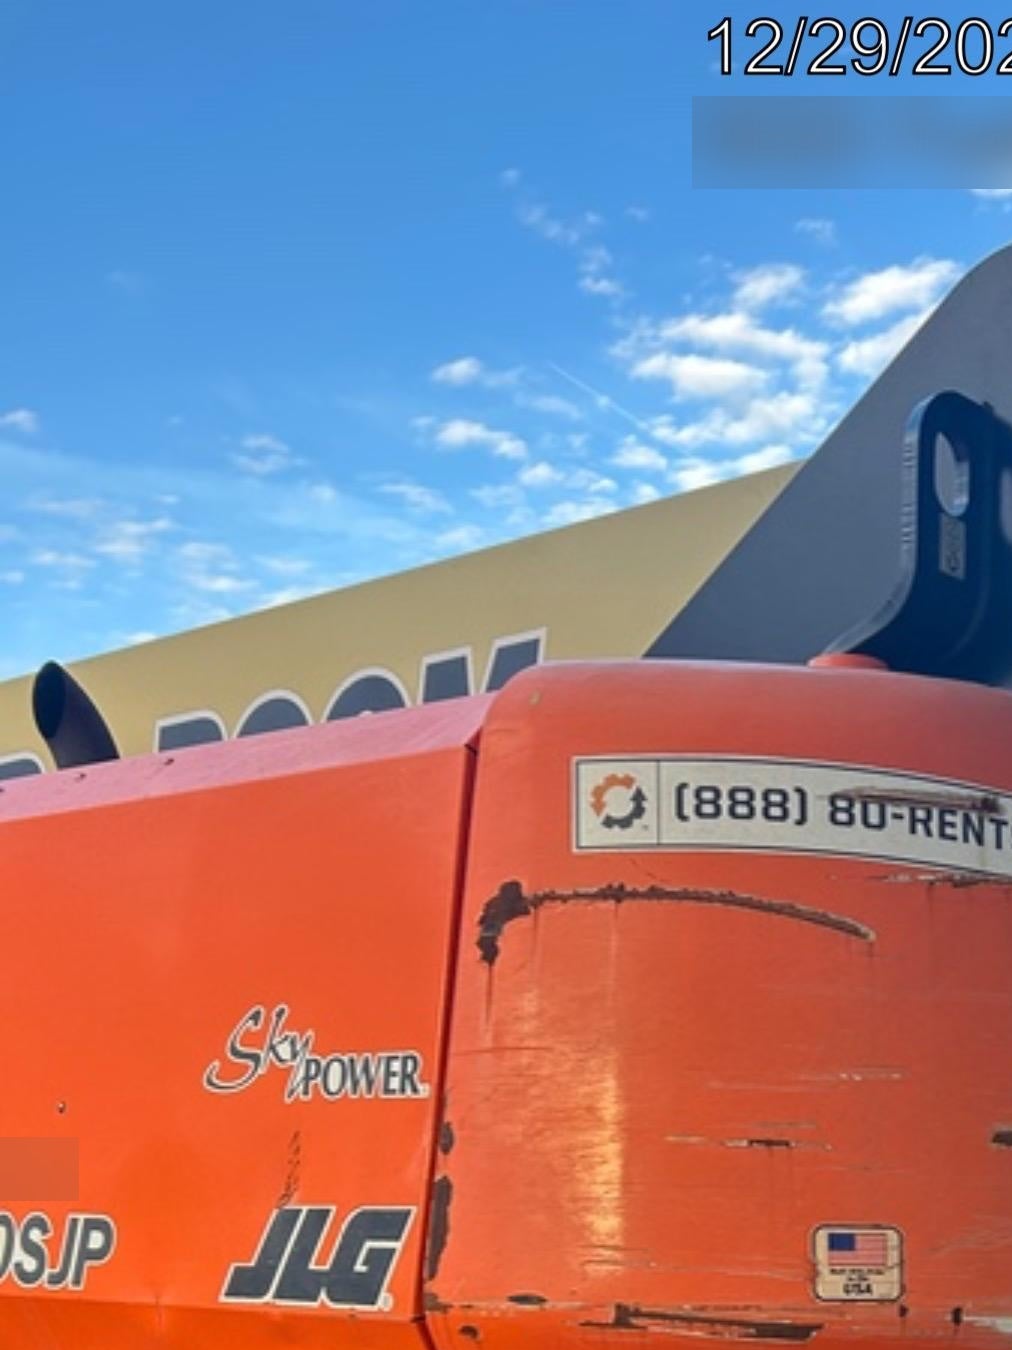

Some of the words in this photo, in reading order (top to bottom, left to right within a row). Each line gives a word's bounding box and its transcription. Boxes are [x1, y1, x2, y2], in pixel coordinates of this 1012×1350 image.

[674, 782, 808, 827] (888)
[204, 1004, 314, 1103] Sky
[301, 1051, 422, 1098] POWER
[219, 1206, 416, 1311] JLG
